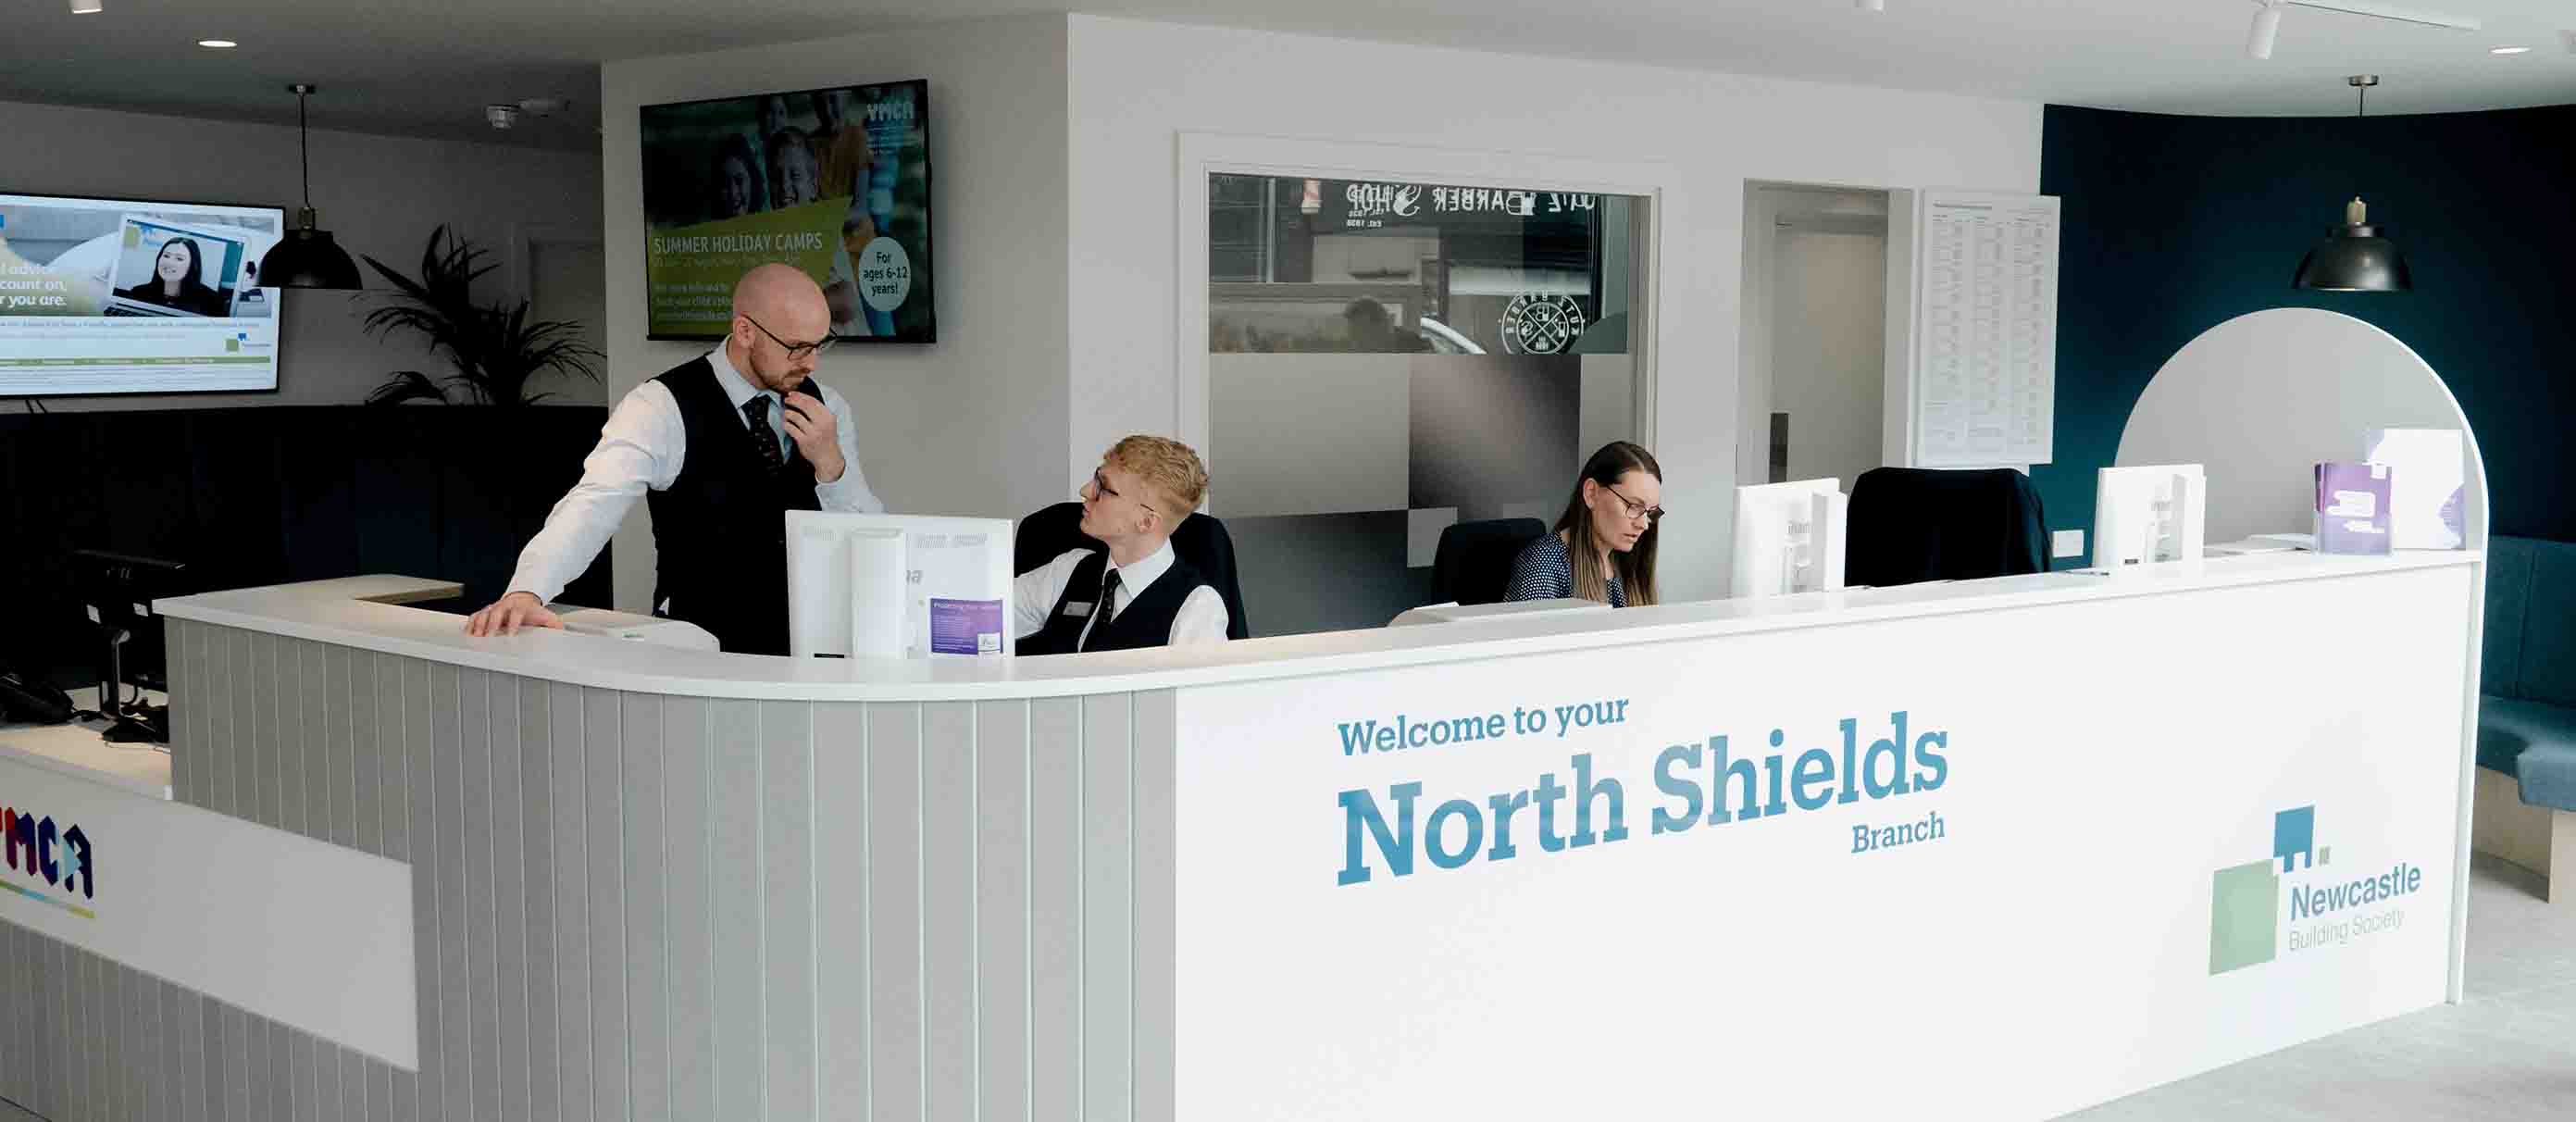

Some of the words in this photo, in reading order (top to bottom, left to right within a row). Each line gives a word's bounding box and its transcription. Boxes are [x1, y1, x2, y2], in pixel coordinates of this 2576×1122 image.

[866, 102, 915, 121] YMCA
[653, 237, 709, 253] SUMMER
[713, 234, 771, 252] HOLIDAY
[775, 232, 823, 250] CAMPS
[876, 251, 890, 264] For
[864, 268, 884, 281] ages
[886, 266, 908, 279] 6-12
[872, 283, 898, 296] years!
[7, 295, 38, 308] you
[1338, 709, 1506, 758] Welcome
[1513, 705, 1547, 734] to
[1554, 695, 1630, 738] your
[1337, 752, 1629, 887] North
[1650, 710, 1949, 837] Shields
[1851, 811, 1947, 854] Branch
[2290, 862, 2421, 921] Newcastle
[2288, 918, 2348, 951] Building
[2353, 908, 2406, 937] Society
